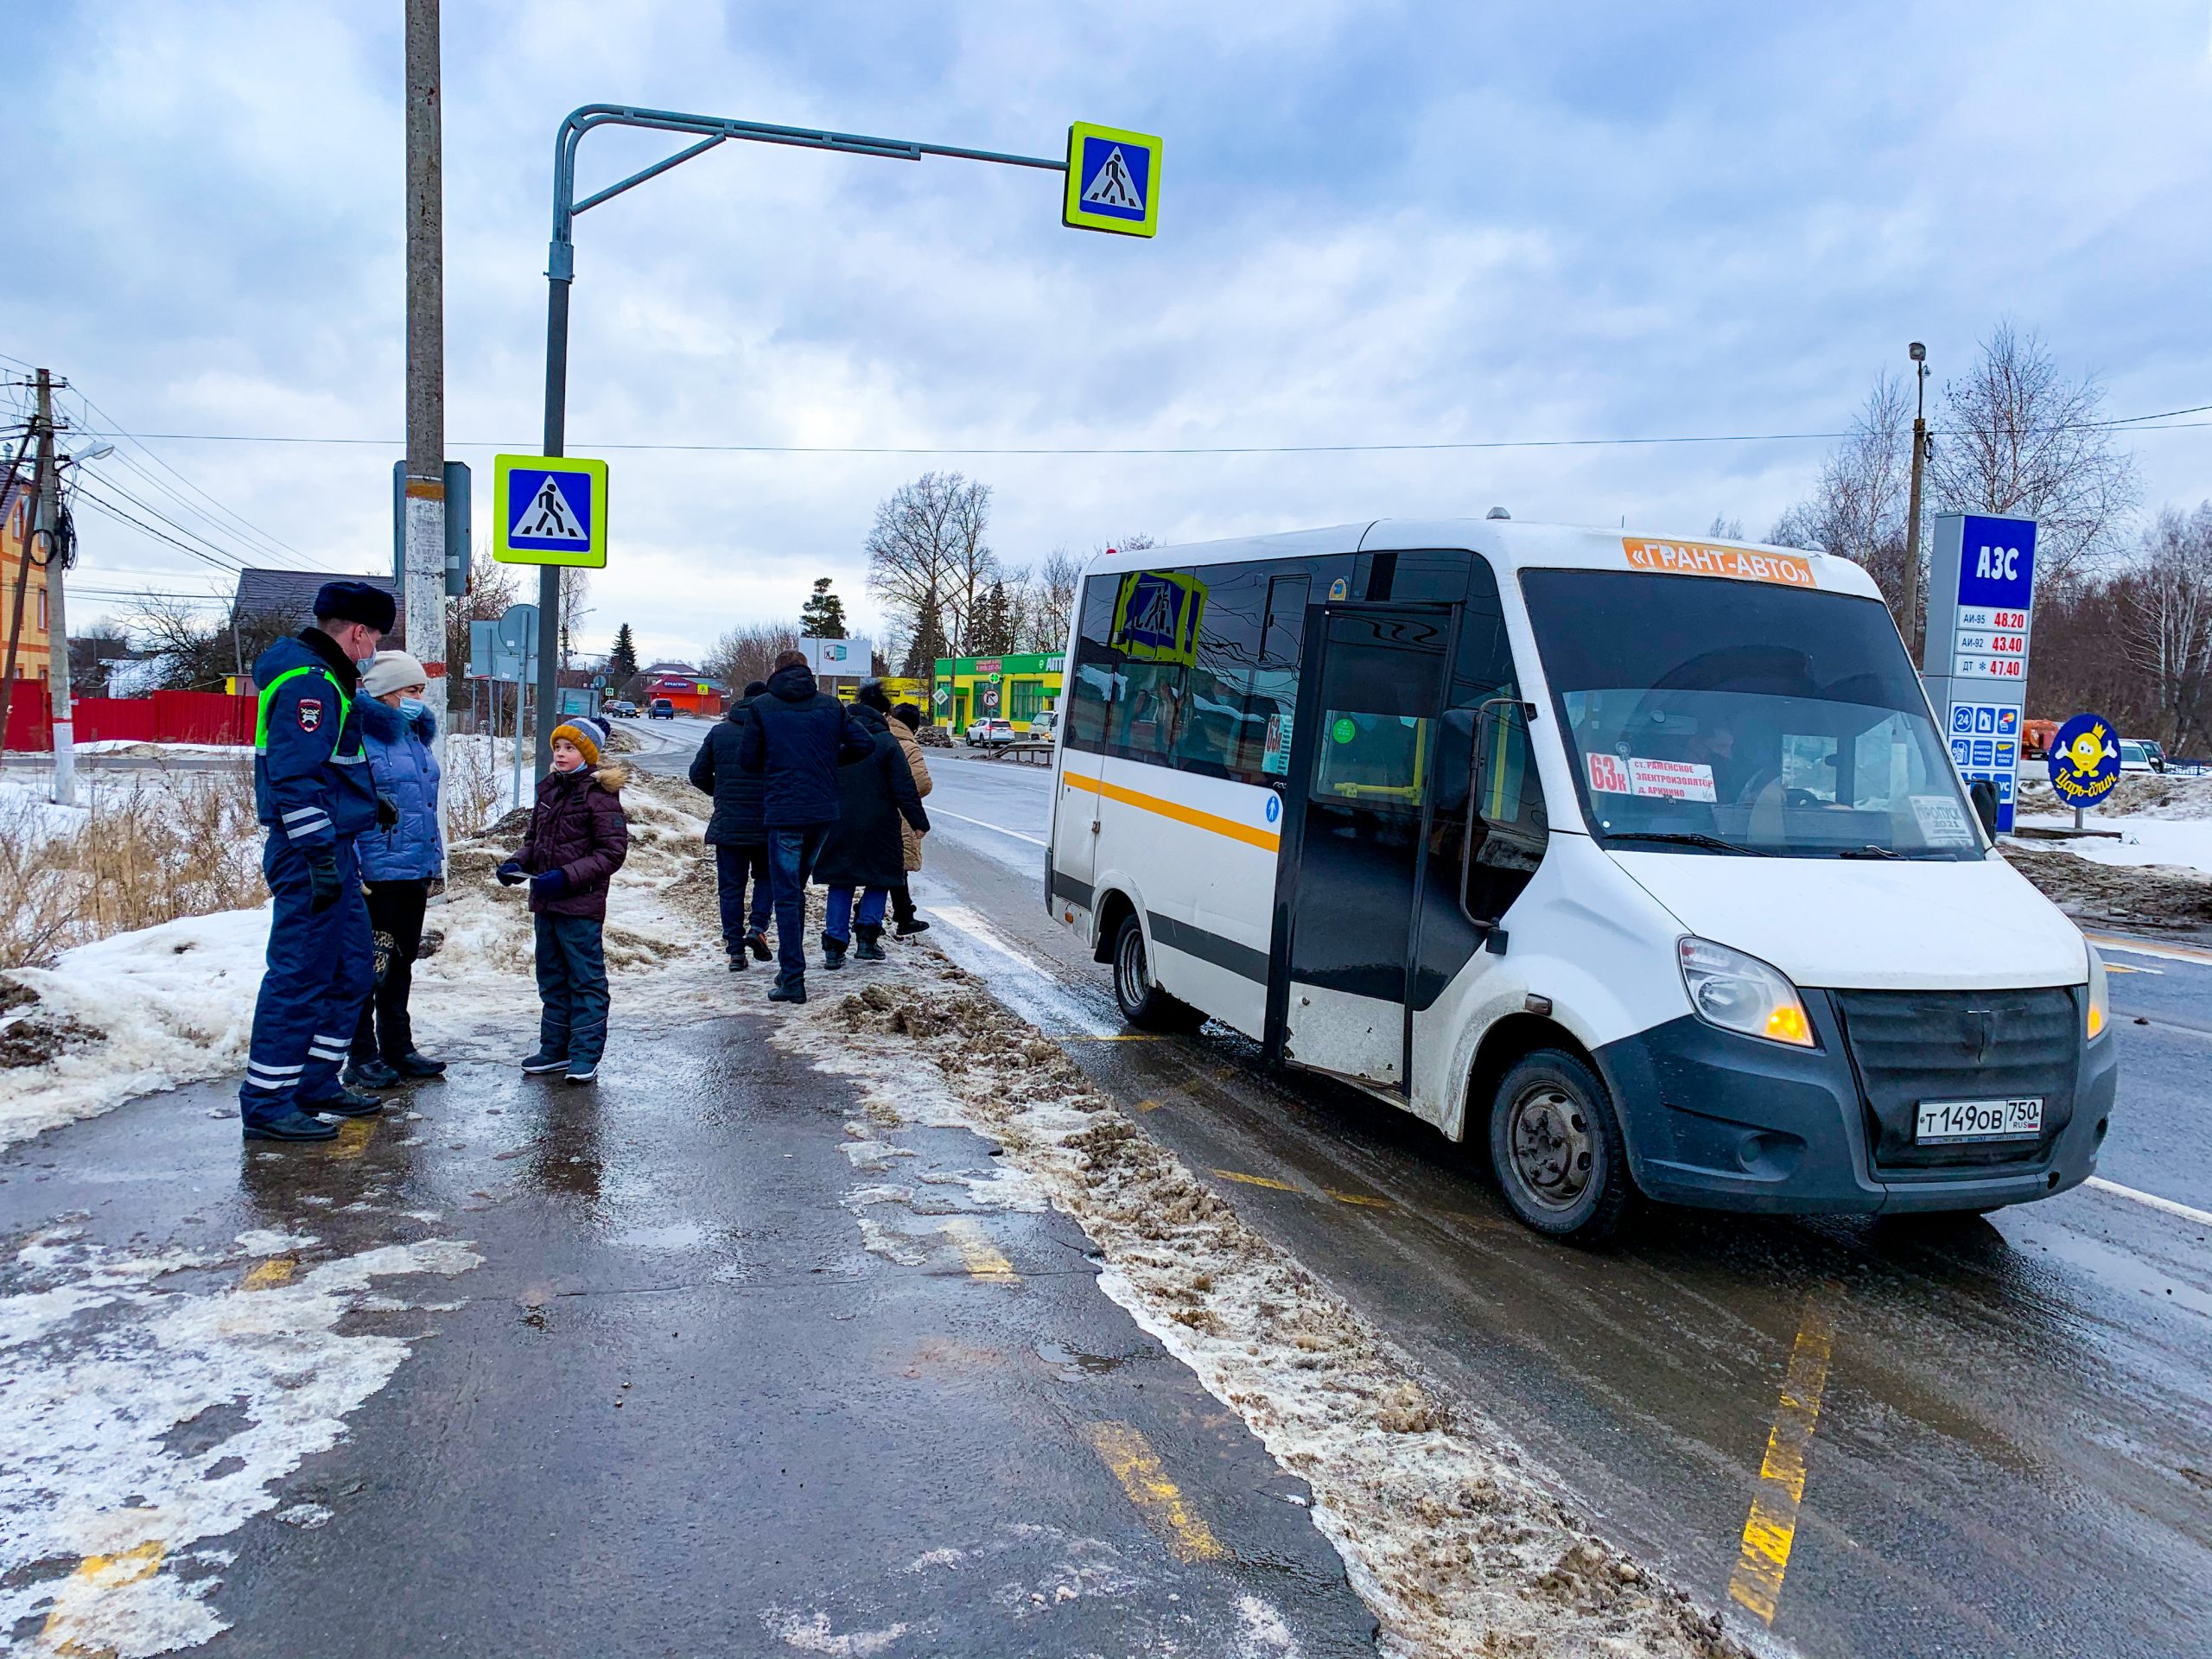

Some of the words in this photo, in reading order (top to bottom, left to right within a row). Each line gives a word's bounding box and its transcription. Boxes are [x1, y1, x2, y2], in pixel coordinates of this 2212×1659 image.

[1975, 545, 2019, 581] АЗС
[1963, 613, 1986, 625] АИ-95
[1994, 612, 2024, 628] 48.20
[1961, 638, 1984, 648] АИ-92
[1992, 636, 2022, 652] 43.40
[1962, 661, 1974, 671] ДТ
[1990, 660, 2019, 677] 47.40
[1957, 714, 1969, 726] 24
[1647, 761, 1694, 773] РАМЕНСКОЕ
[1636, 772, 1713, 788] ЭЛЕКТРОИЗОЛЯТОР
[2055, 767, 2117, 801] Царь-блин
[1916, 806, 1963, 821] ПРОПУСК
[2009, 1102, 2037, 1122] 750
